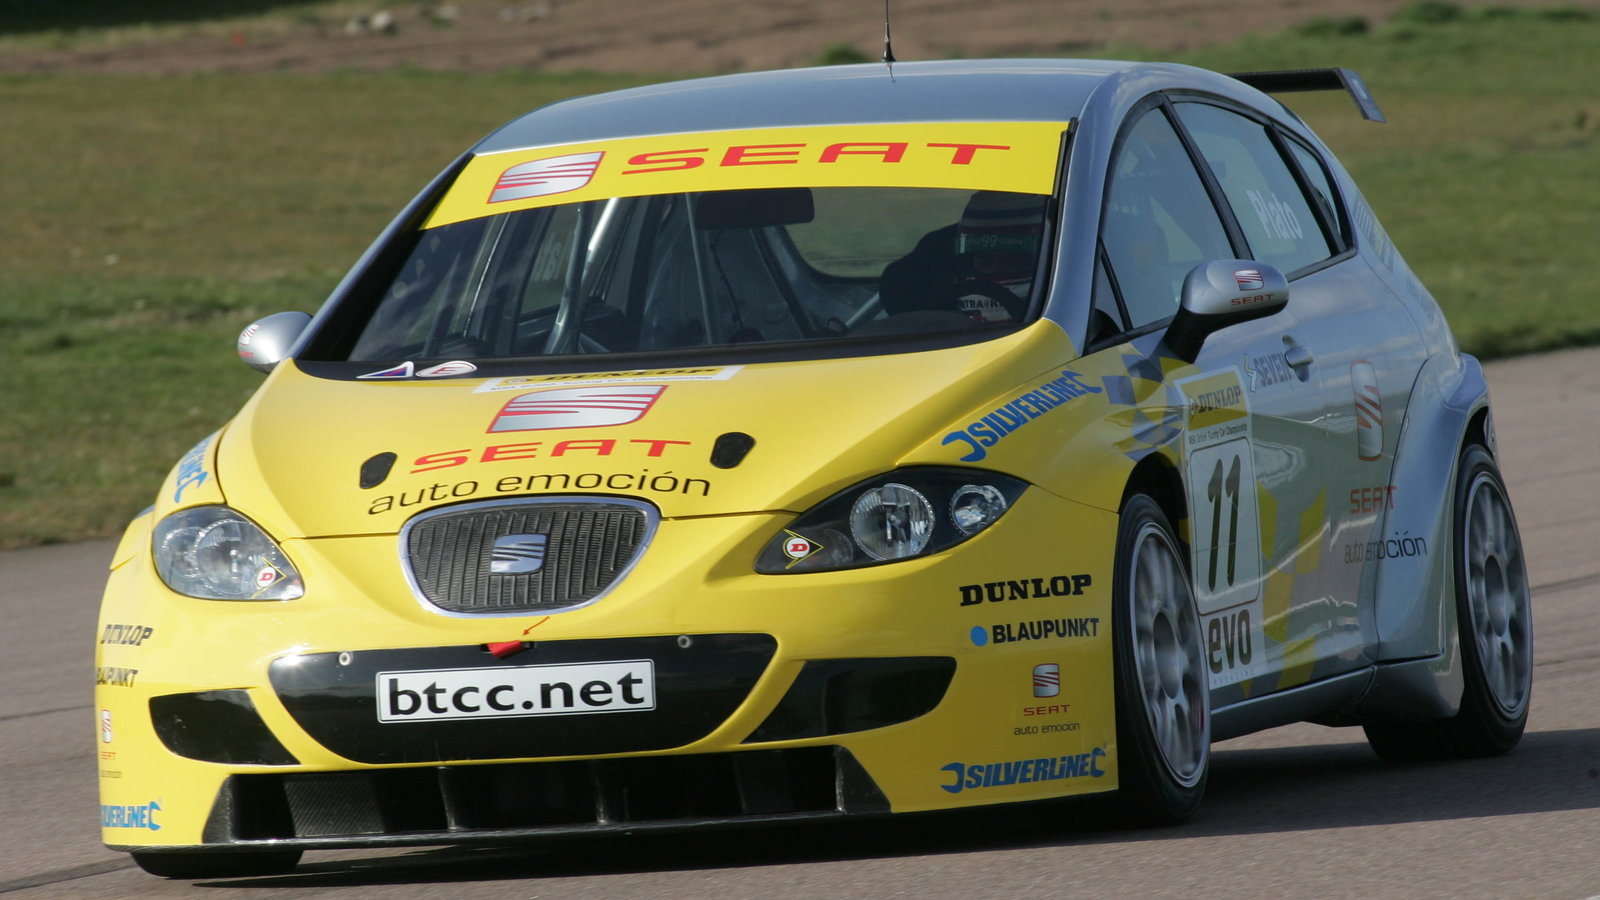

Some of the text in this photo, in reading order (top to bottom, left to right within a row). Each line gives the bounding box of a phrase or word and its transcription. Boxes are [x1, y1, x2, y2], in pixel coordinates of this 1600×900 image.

[621, 142, 1011, 175] SEAT
[1246, 190, 1303, 240] Plato
[1231, 293, 1275, 306] SEAT
[1253, 352, 1292, 387] SEVEN
[1198, 385, 1242, 414] DUNLOP
[410, 439, 691, 474] SEAT
[367, 468, 711, 516] auto emoción
[1350, 485, 1398, 514] SEAT
[1208, 454, 1241, 592] 11
[1344, 530, 1428, 564] auto emoción
[958, 574, 1092, 607] DUNLOP
[100, 624, 154, 646] DUNLOP
[992, 618, 1099, 644] BLAUPUNKT
[1209, 609, 1252, 674] evo
[388, 671, 645, 716] btcc.net
[1023, 704, 1070, 716] SEAT
[1013, 724, 1038, 736] auto
